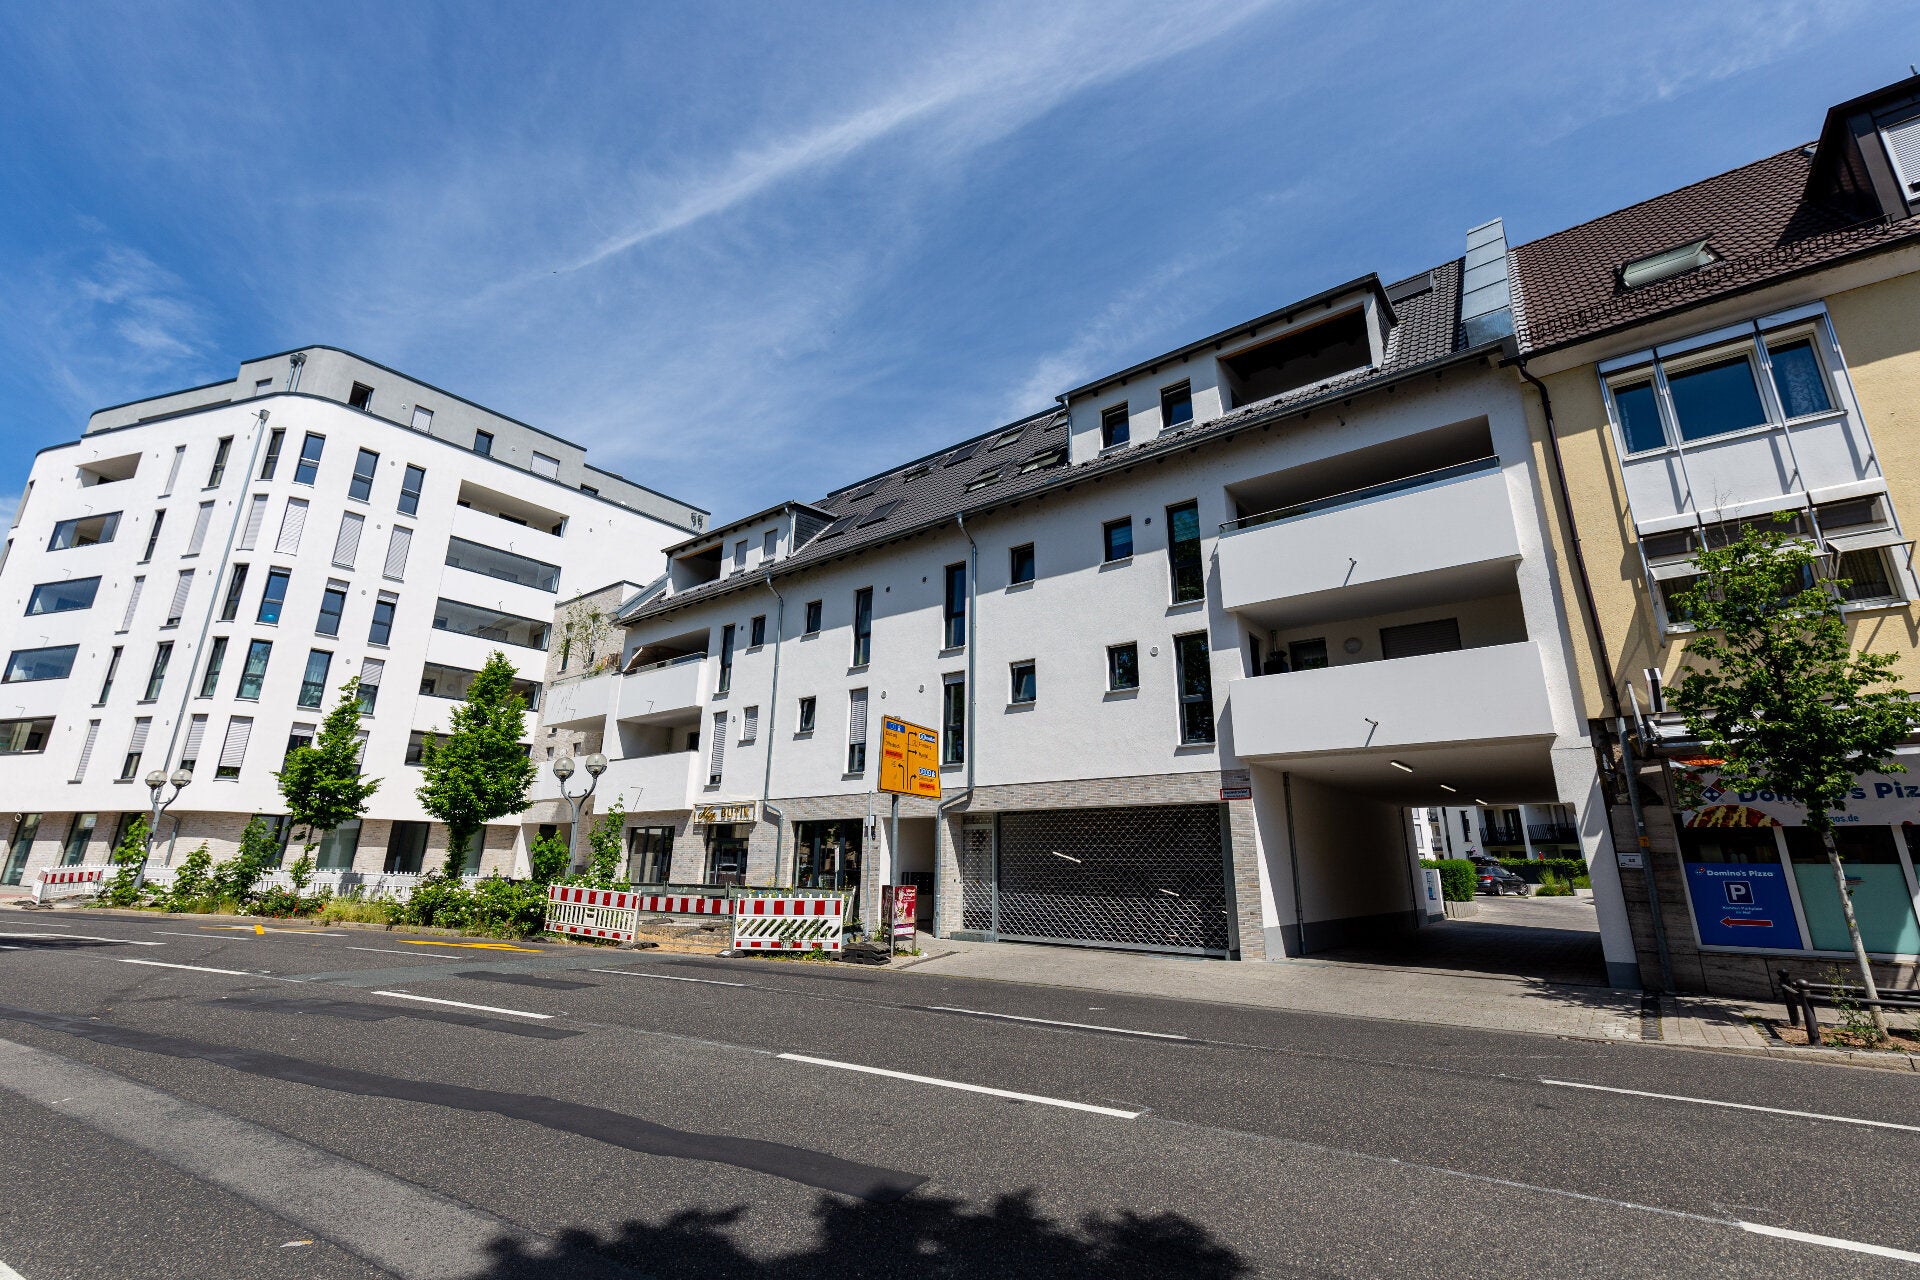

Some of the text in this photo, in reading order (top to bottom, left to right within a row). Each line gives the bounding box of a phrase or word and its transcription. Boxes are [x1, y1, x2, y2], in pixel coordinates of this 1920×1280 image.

[721, 805, 750, 819] BUTIK
[1706, 869, 1774, 878] Domino's Pizza
[1729, 884, 1746, 901] P
